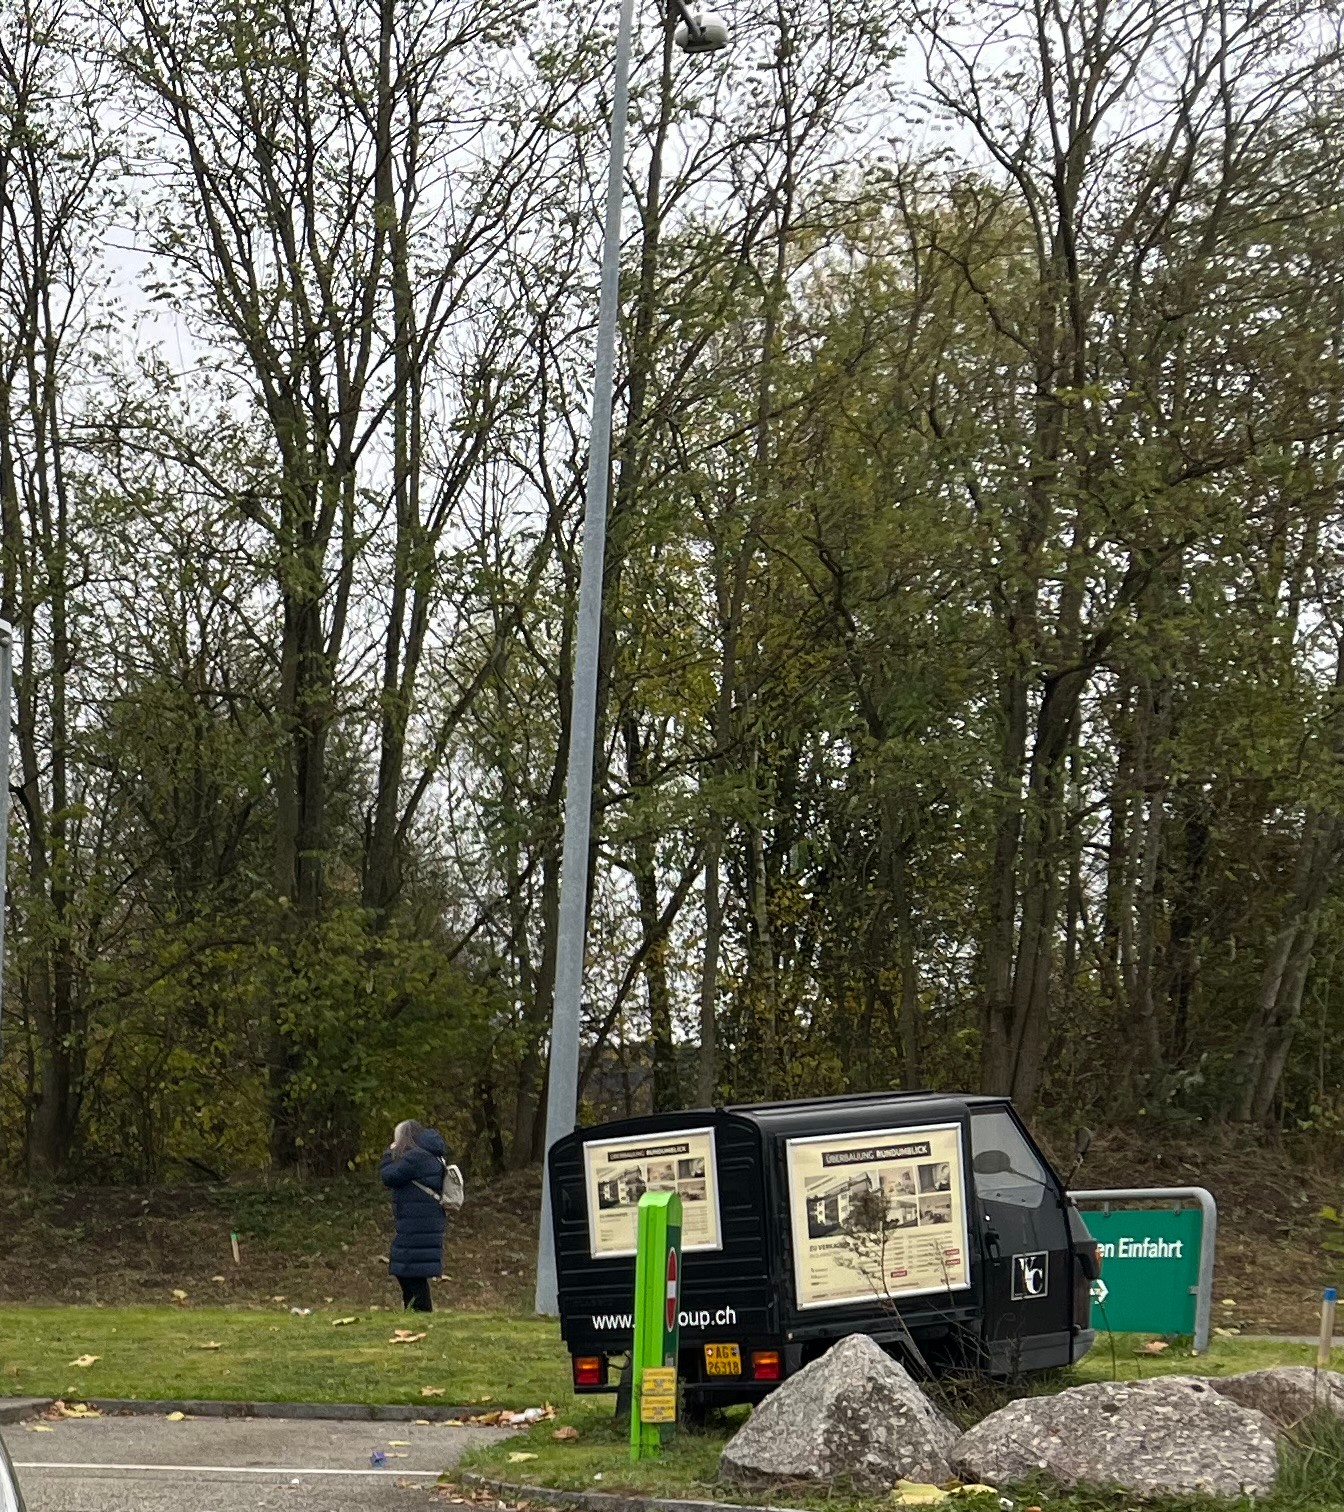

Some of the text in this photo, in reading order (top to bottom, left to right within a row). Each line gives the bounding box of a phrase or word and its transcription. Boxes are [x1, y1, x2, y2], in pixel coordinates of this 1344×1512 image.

[1118, 1237, 1184, 1258] Einfahrt
[715, 1348, 729, 1359] AG
[708, 1361, 740, 1375] 26318
